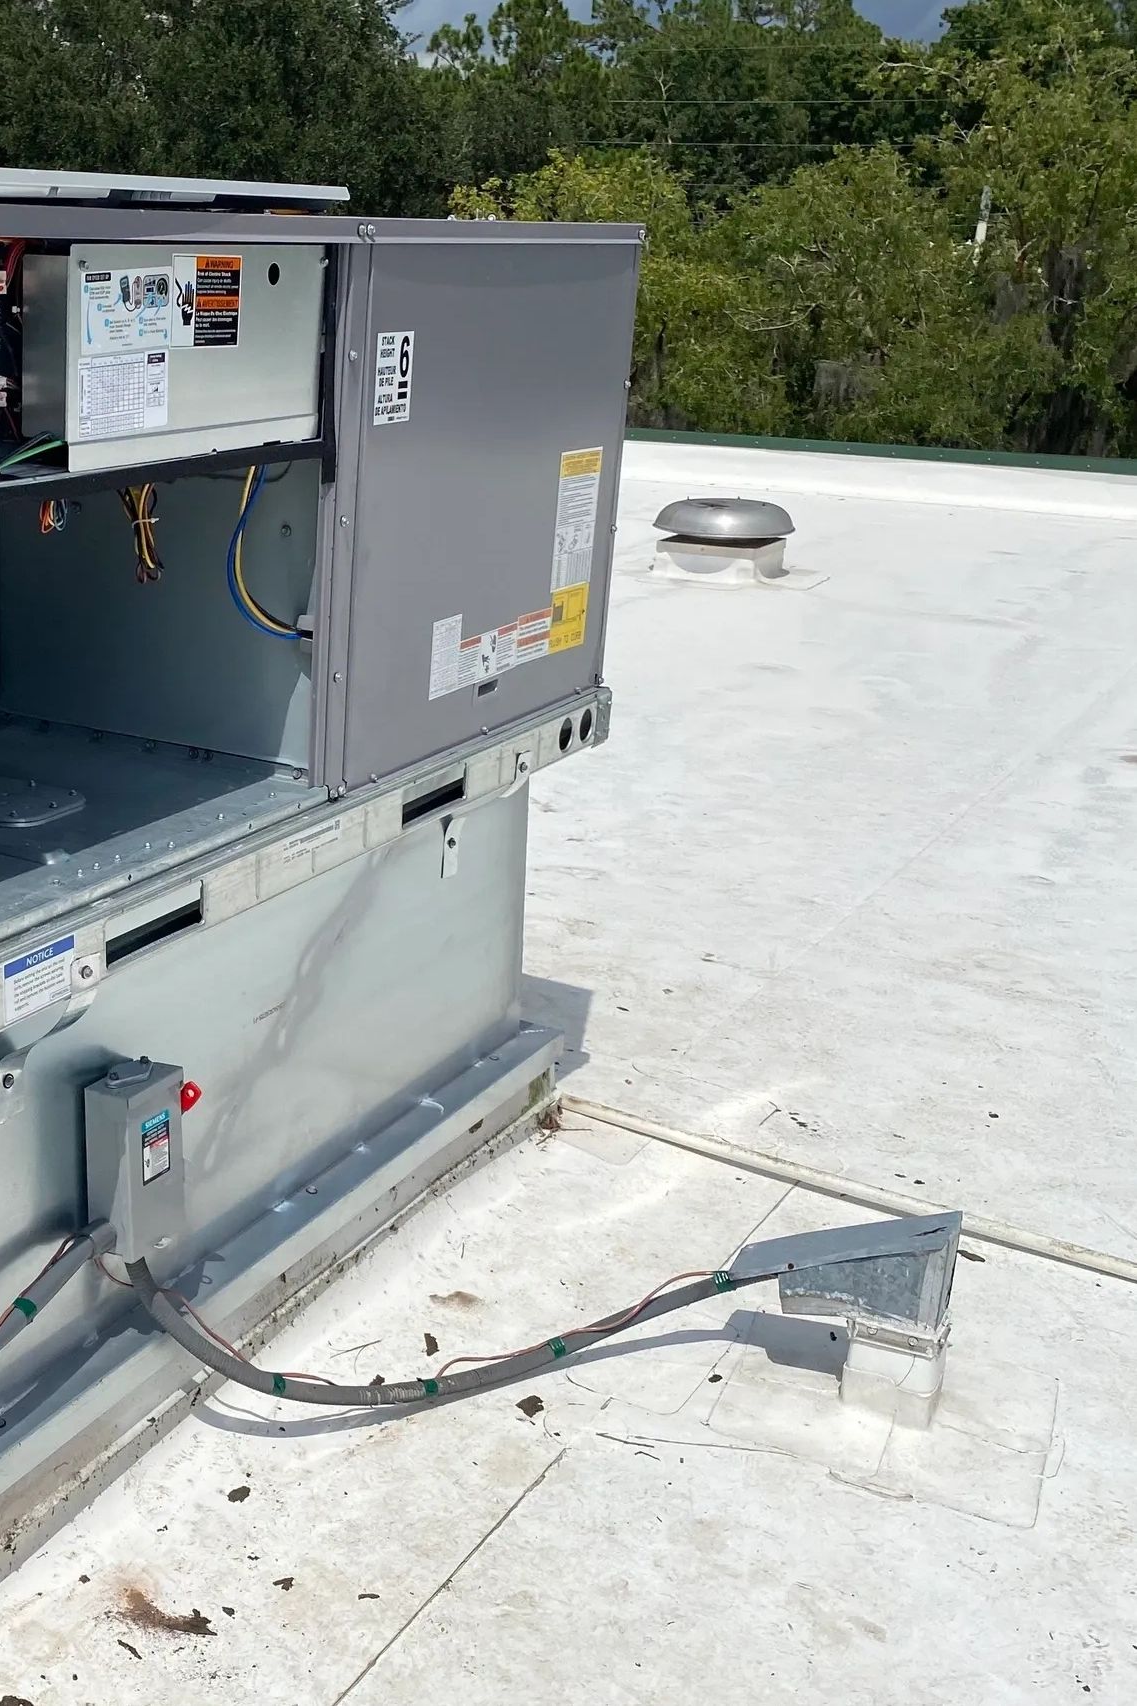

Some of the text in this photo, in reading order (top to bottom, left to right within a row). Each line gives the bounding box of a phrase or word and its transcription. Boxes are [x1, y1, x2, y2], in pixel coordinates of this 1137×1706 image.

[382, 336, 395, 346] STACK
[380, 348, 395, 358] HEIGHT
[400, 336, 410, 377] 6
[378, 366, 396, 376] HAUTEUR
[379, 377, 394, 387] DE PILE
[378, 393, 393, 404] ALTURA
[375, 404, 406, 416] DE APILAMIENTO
[26, 948, 54, 966] NOTICE
[145, 1112, 166, 1129] SIEMENS
